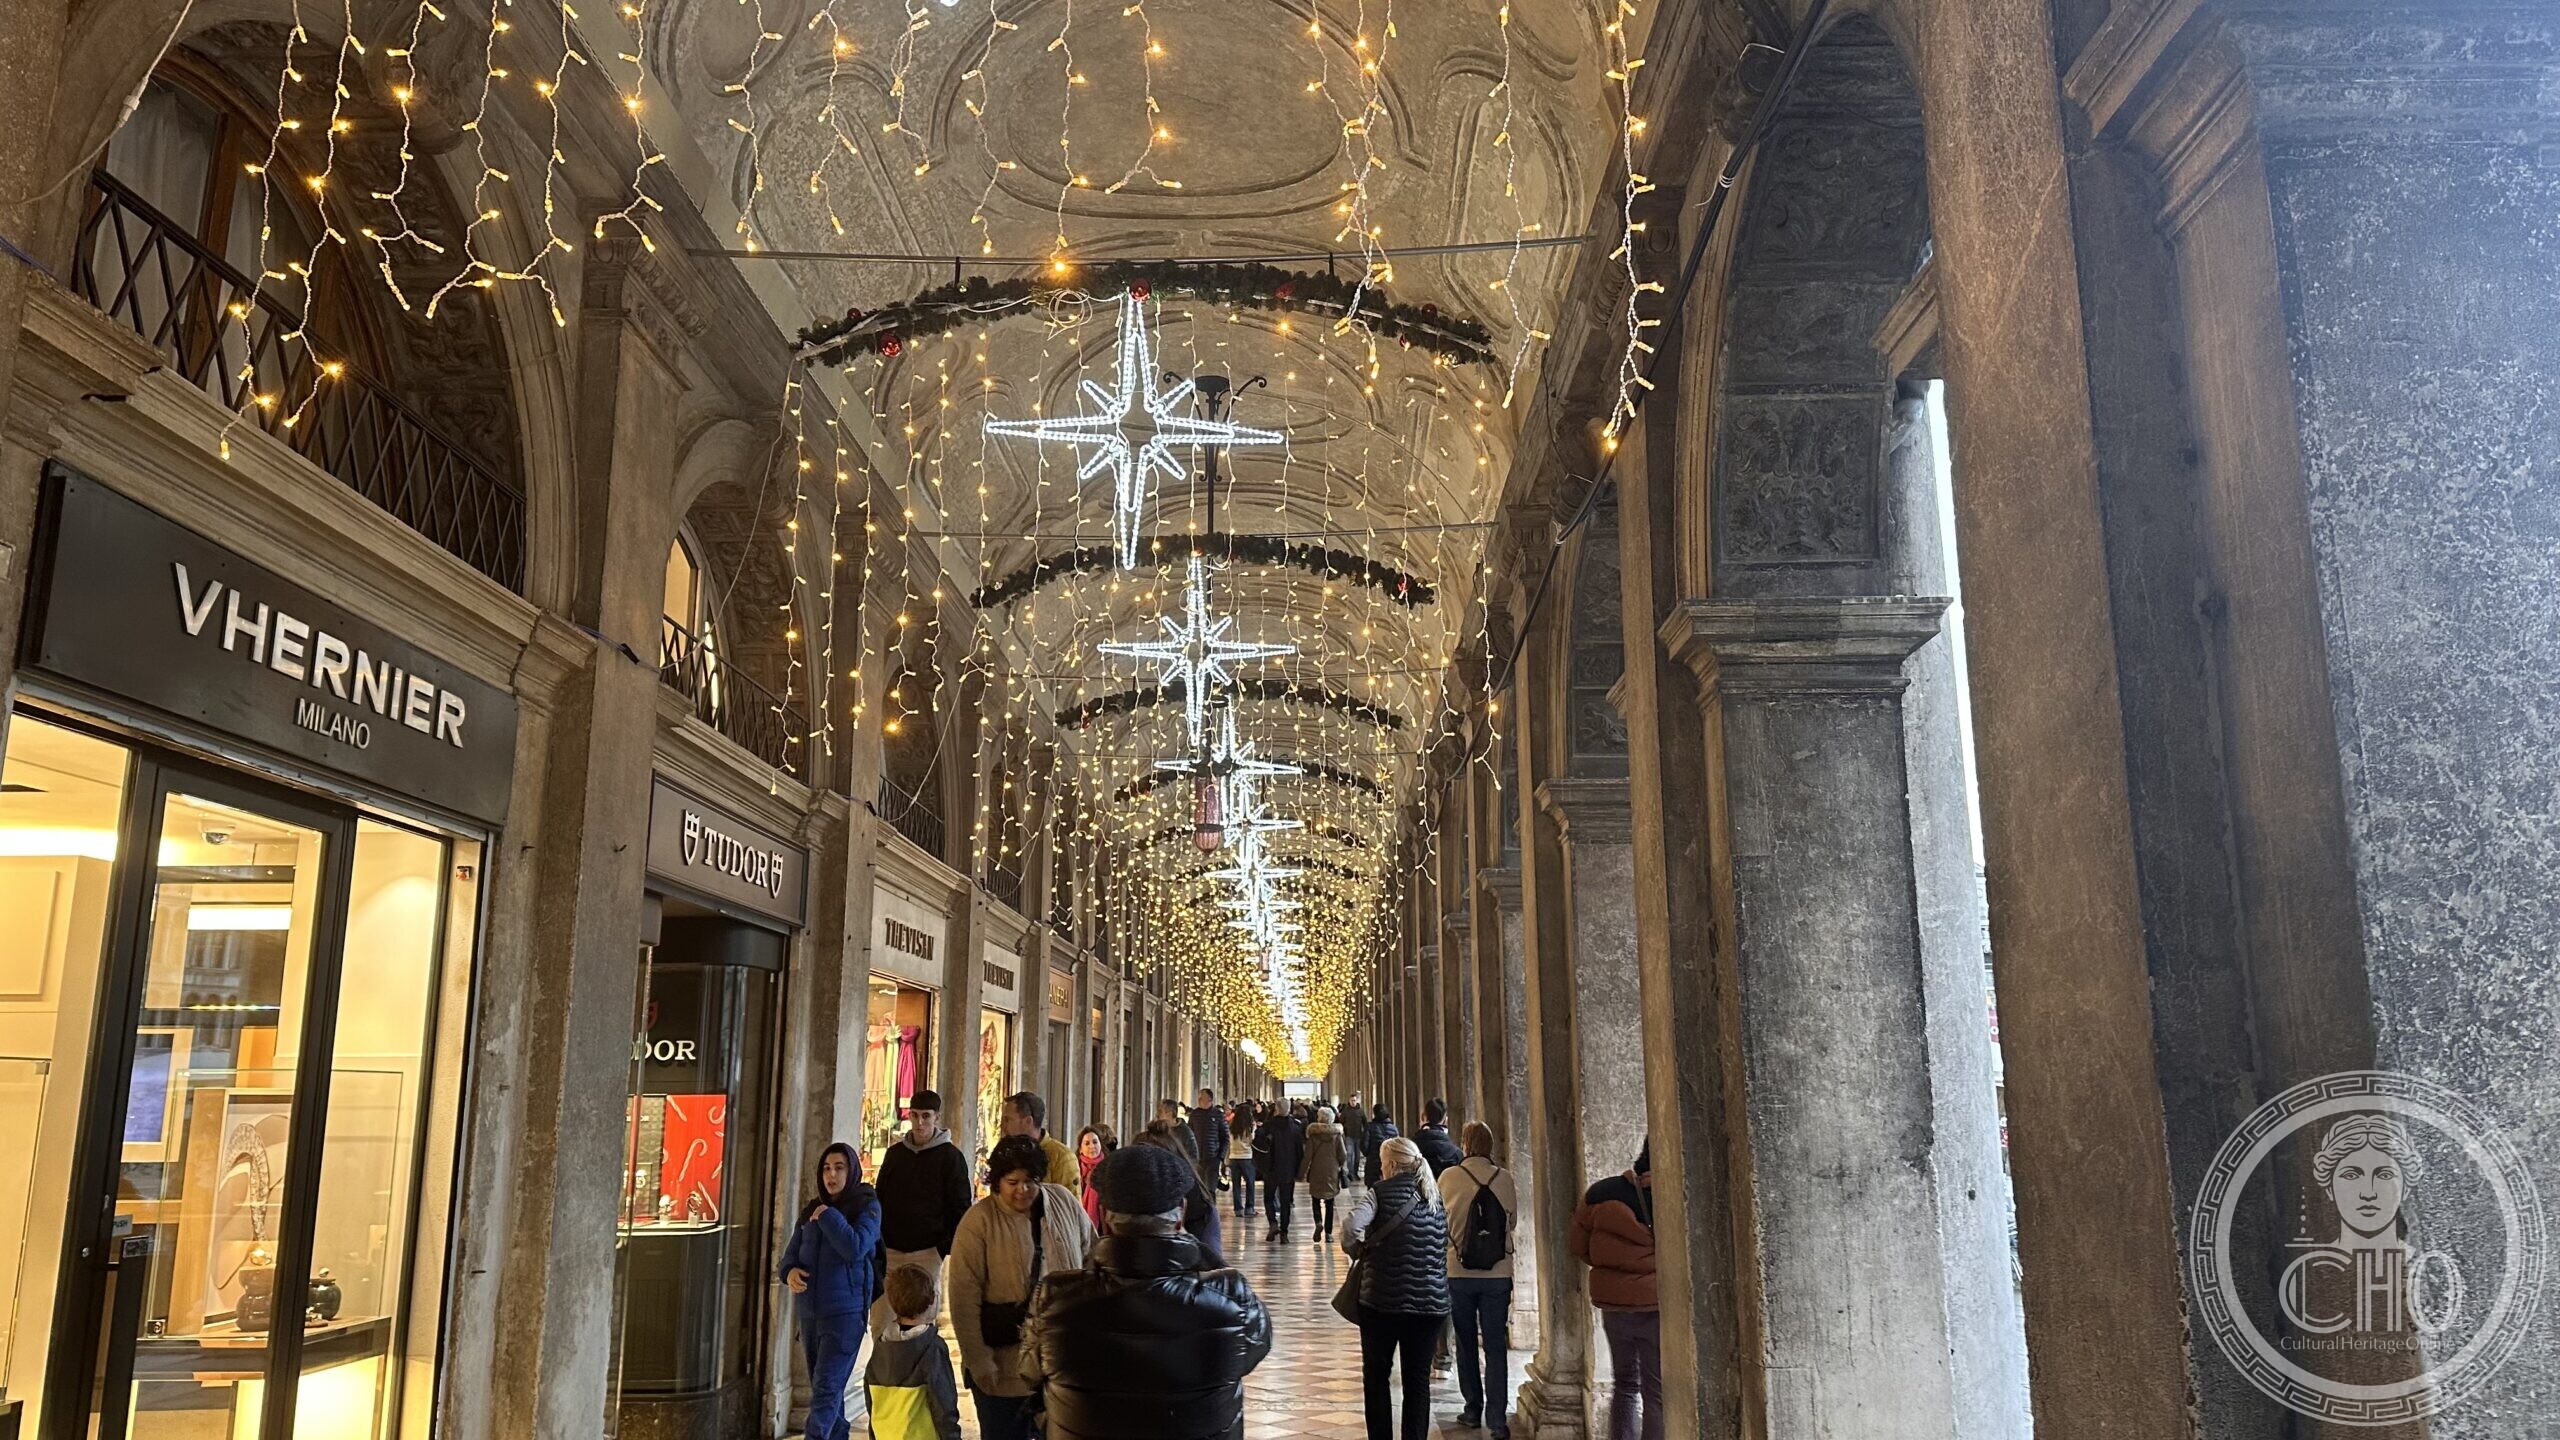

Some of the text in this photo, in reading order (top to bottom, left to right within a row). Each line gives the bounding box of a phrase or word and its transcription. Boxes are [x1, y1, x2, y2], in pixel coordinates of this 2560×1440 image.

[174, 561, 465, 748] VHERNIER
[297, 697, 371, 750] MILANO
[704, 826, 768, 888] TUDOR
